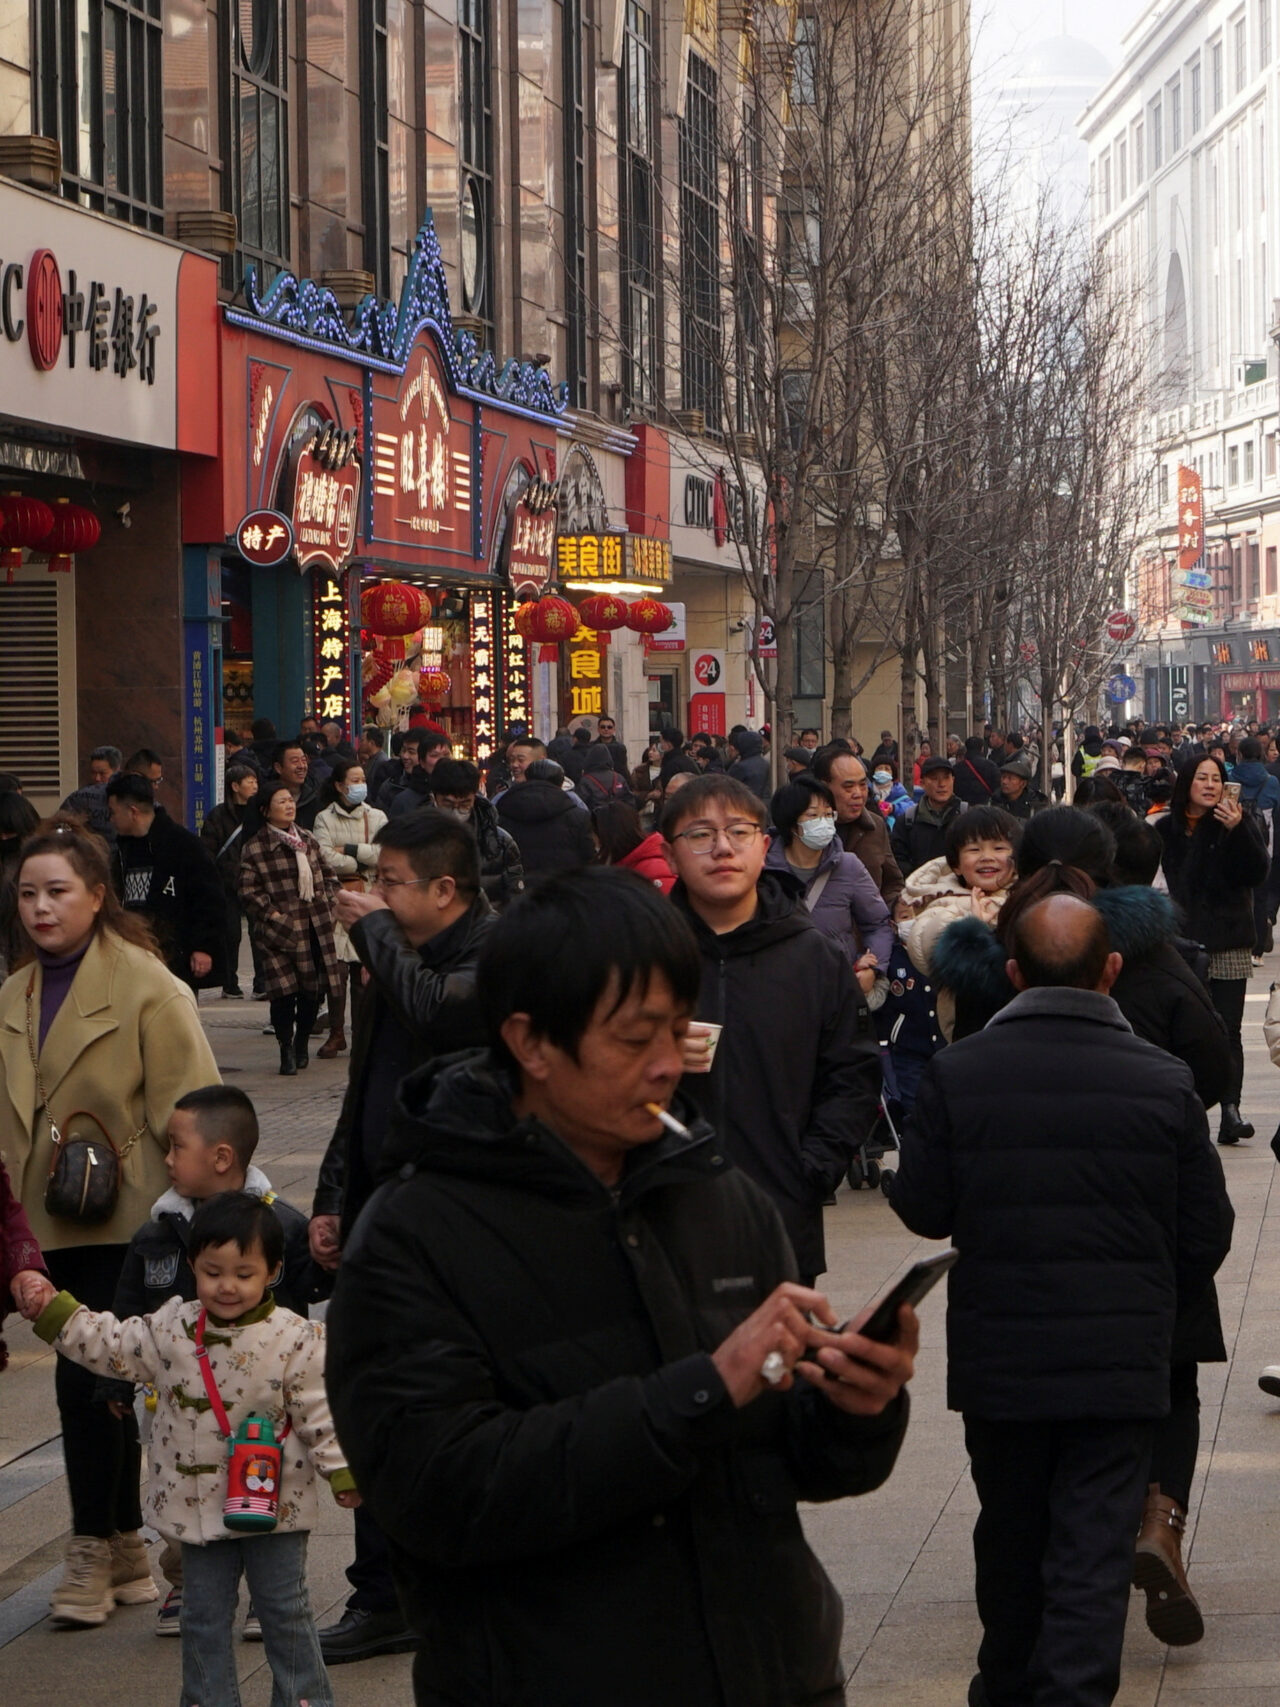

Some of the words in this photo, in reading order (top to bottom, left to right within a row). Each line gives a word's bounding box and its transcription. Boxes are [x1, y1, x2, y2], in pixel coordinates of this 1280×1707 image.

[0, 258, 24, 342] C
[62, 269, 160, 386] 中信银行
[243, 524, 285, 551] 特产
[557, 535, 622, 577] 美食街
[320, 580, 344, 719] 上海特产店
[698, 660, 718, 679] 24
[162, 876, 176, 897] A
